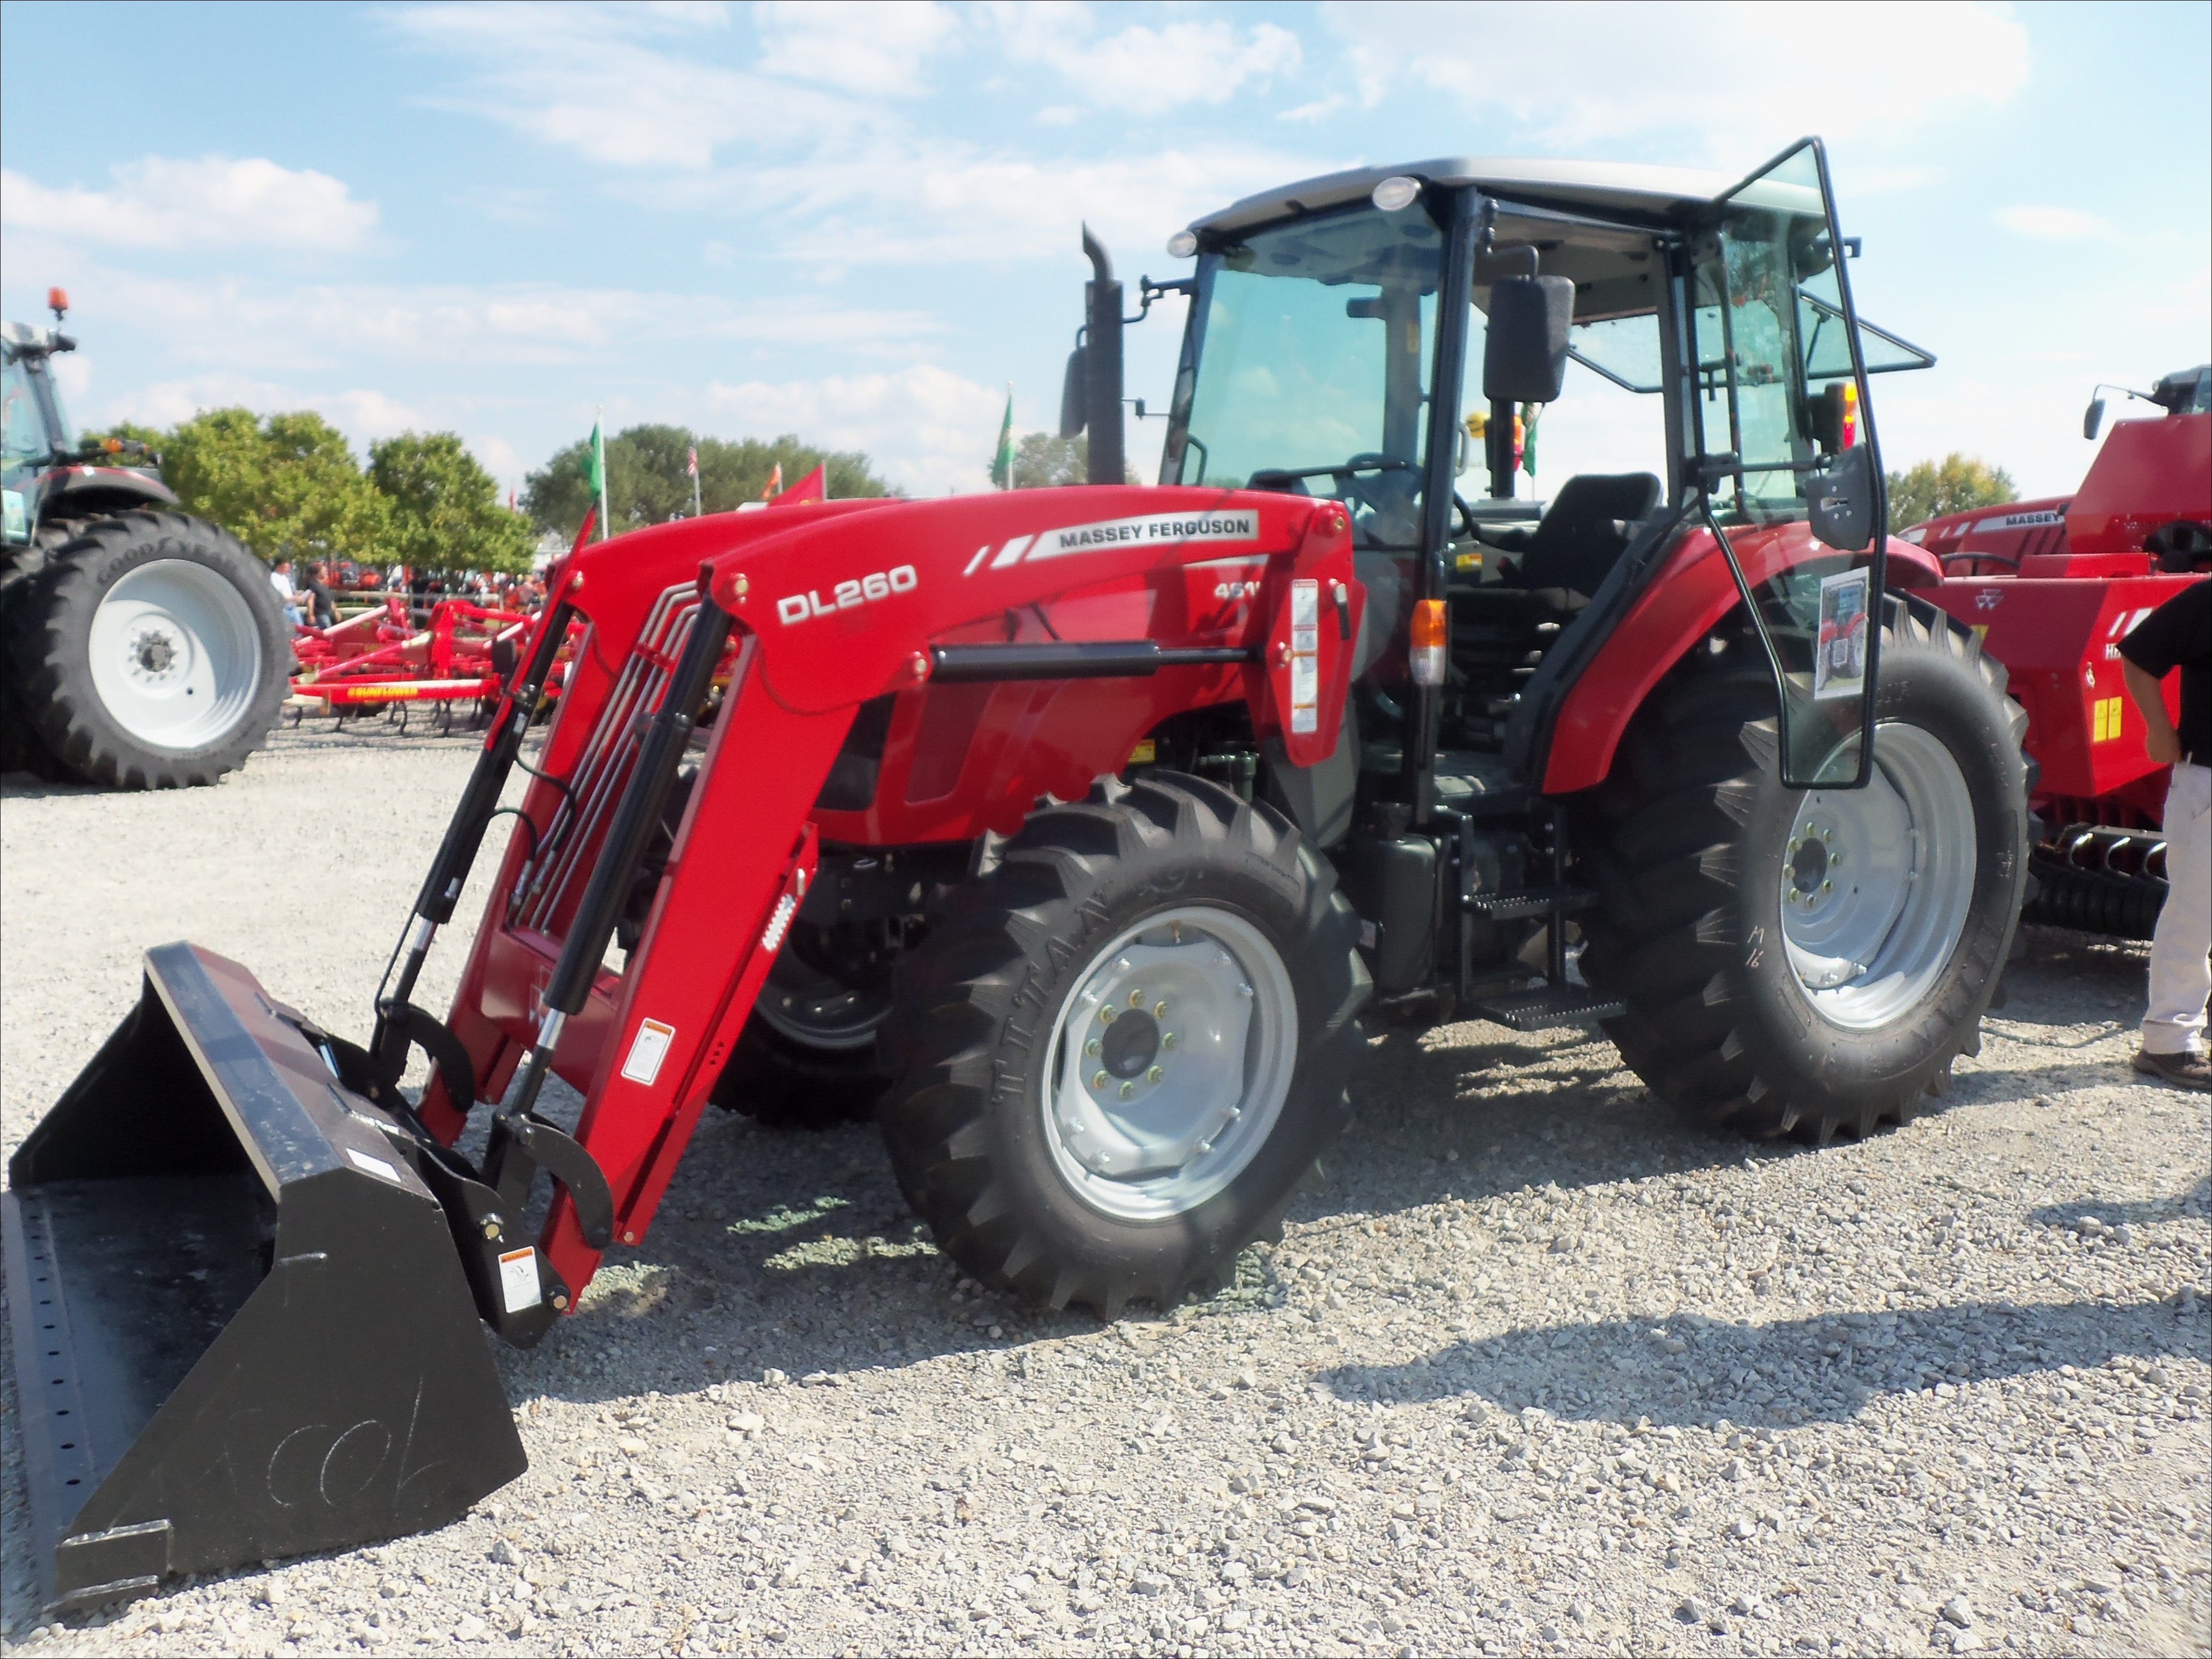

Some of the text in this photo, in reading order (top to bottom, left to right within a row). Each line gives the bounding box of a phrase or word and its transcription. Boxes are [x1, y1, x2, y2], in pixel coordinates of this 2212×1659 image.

[1059, 519, 1250, 548] MASSEY FERGUSON
[2006, 513, 2058, 525] MASSEY
[777, 565, 918, 625] DL260
[356, 686, 419, 698] SUNFLOWER
[991, 880, 1115, 1104] TITAN
